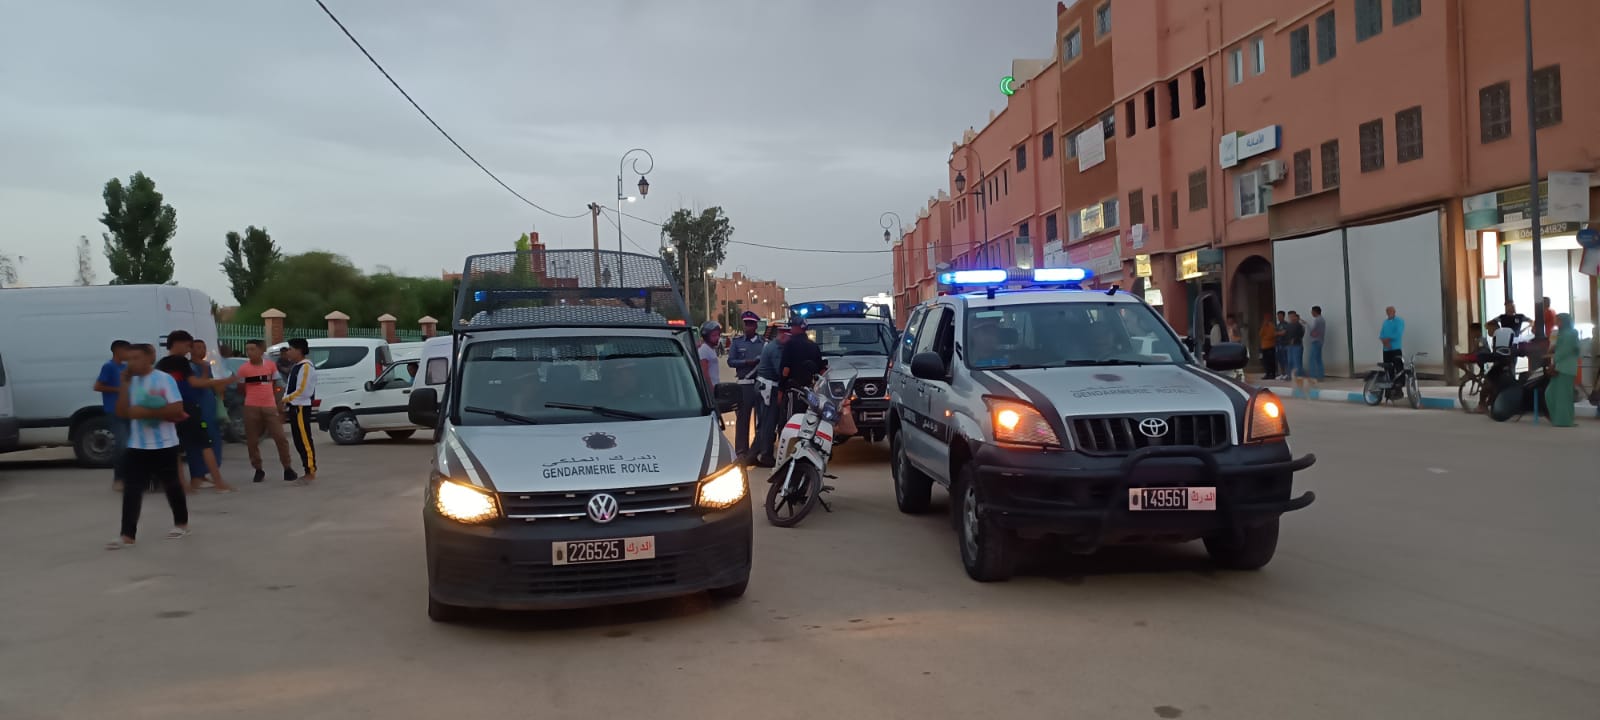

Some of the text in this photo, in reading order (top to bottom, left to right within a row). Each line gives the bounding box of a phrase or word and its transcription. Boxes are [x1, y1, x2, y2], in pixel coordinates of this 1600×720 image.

[542, 462, 660, 479] GENDARMERIE ROYALE
[1143, 490, 1186, 507] 149561
[569, 541, 620, 561] 226525
